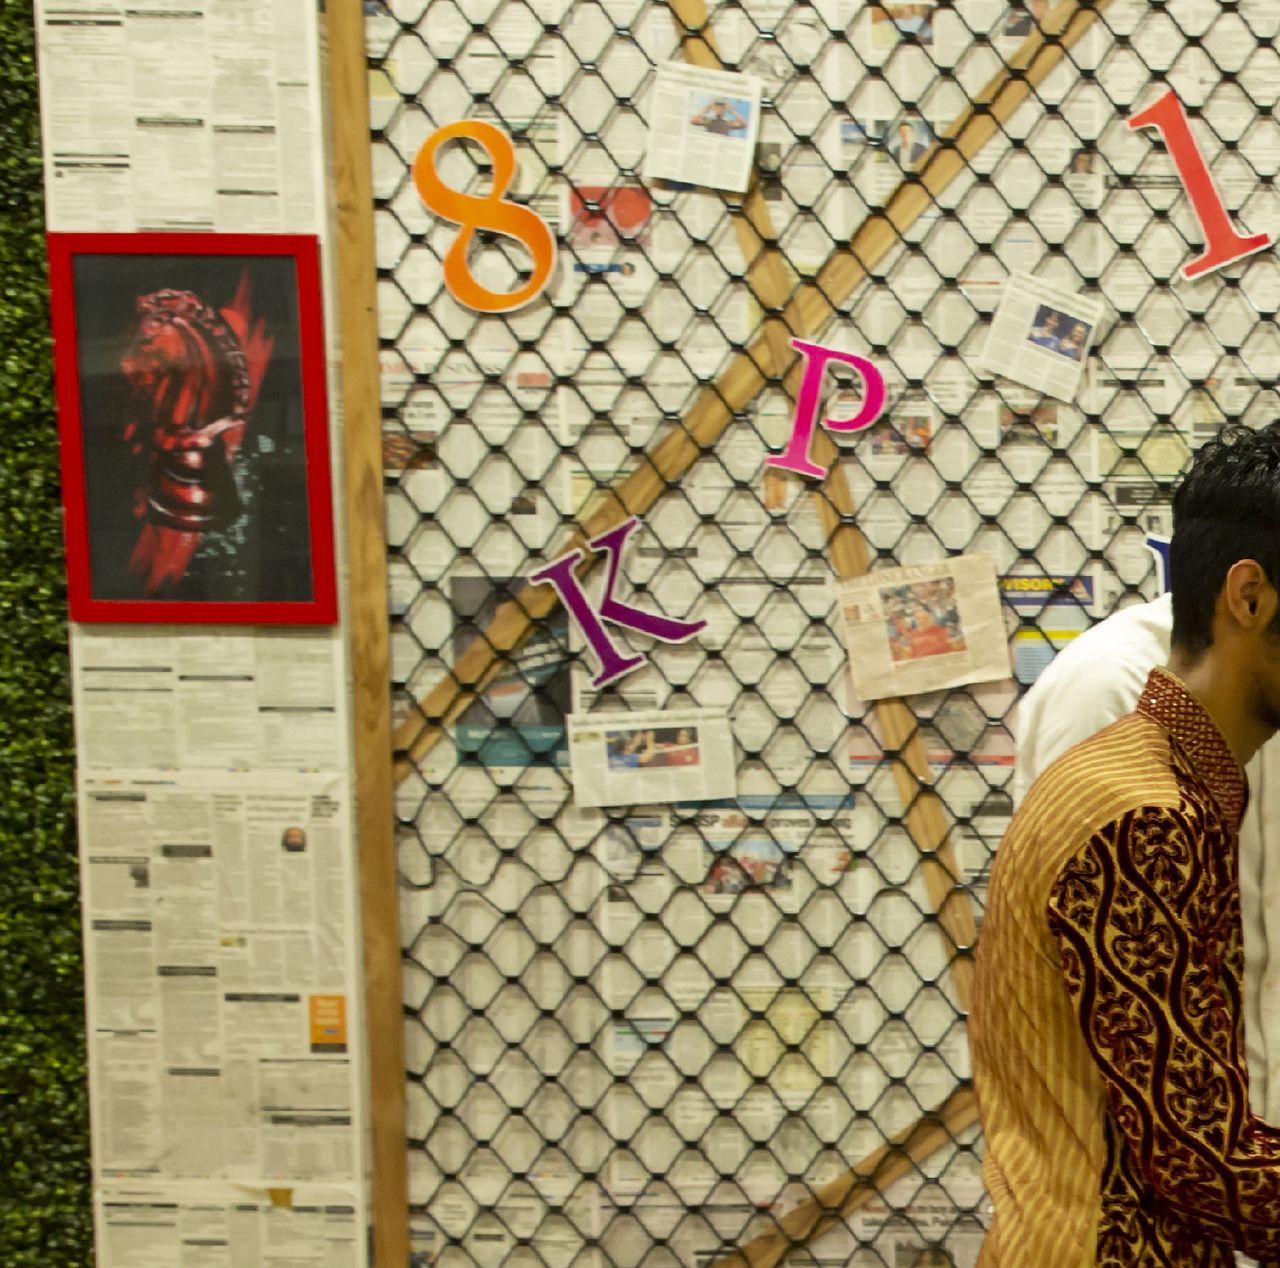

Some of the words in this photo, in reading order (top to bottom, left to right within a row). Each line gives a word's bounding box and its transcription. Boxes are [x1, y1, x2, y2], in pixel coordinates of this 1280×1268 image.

[412, 120, 557, 313] 8
[1127, 90, 1271, 280] 1
[765, 336, 887, 479] P
[529, 516, 709, 687] K
